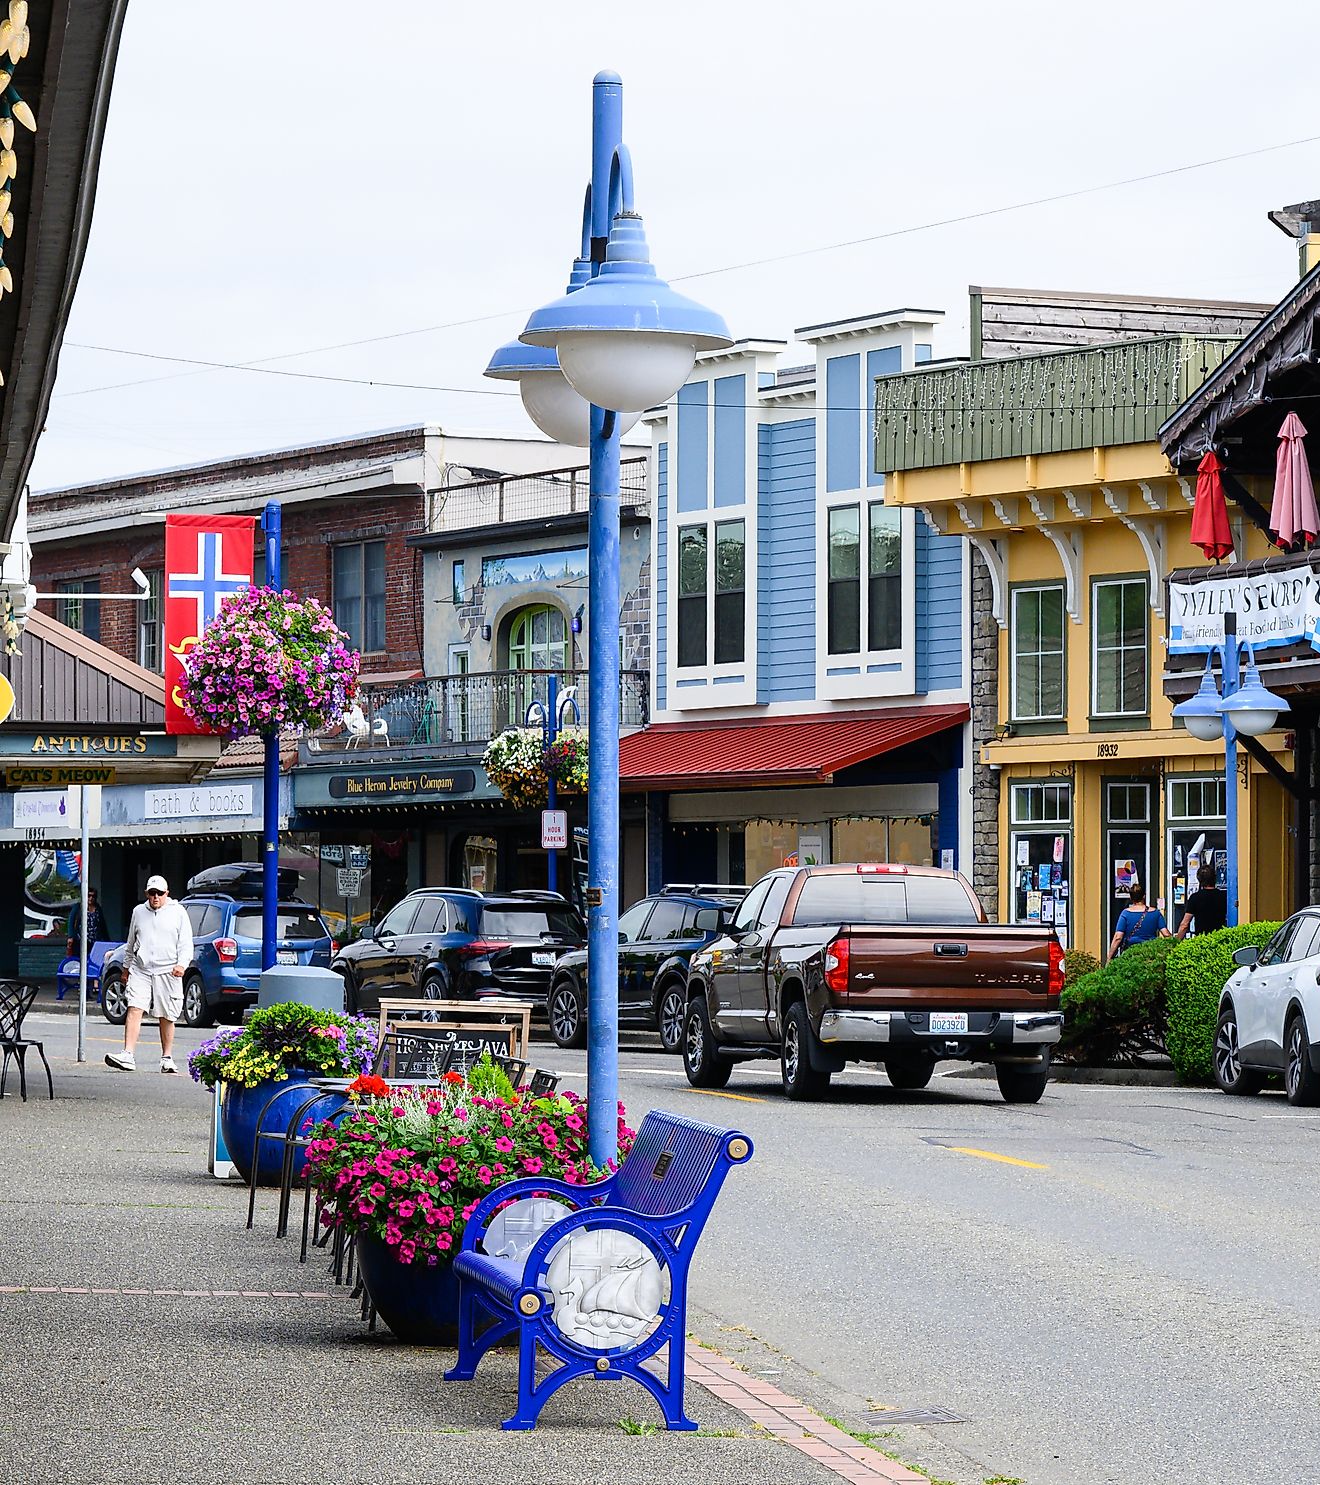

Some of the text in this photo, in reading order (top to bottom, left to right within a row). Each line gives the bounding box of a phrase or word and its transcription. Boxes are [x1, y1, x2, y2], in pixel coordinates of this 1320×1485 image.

[31, 735, 147, 753] ANTIQUES
[1096, 743, 1119, 758] 18932
[9, 768, 112, 783] CAT'S MEOW
[346, 774, 455, 793] Blue Heron Jewelry Company
[152, 794, 182, 815] bath
[208, 790, 245, 812] books
[25, 828, 46, 840] 18954
[544, 835, 565, 843] PARKING
